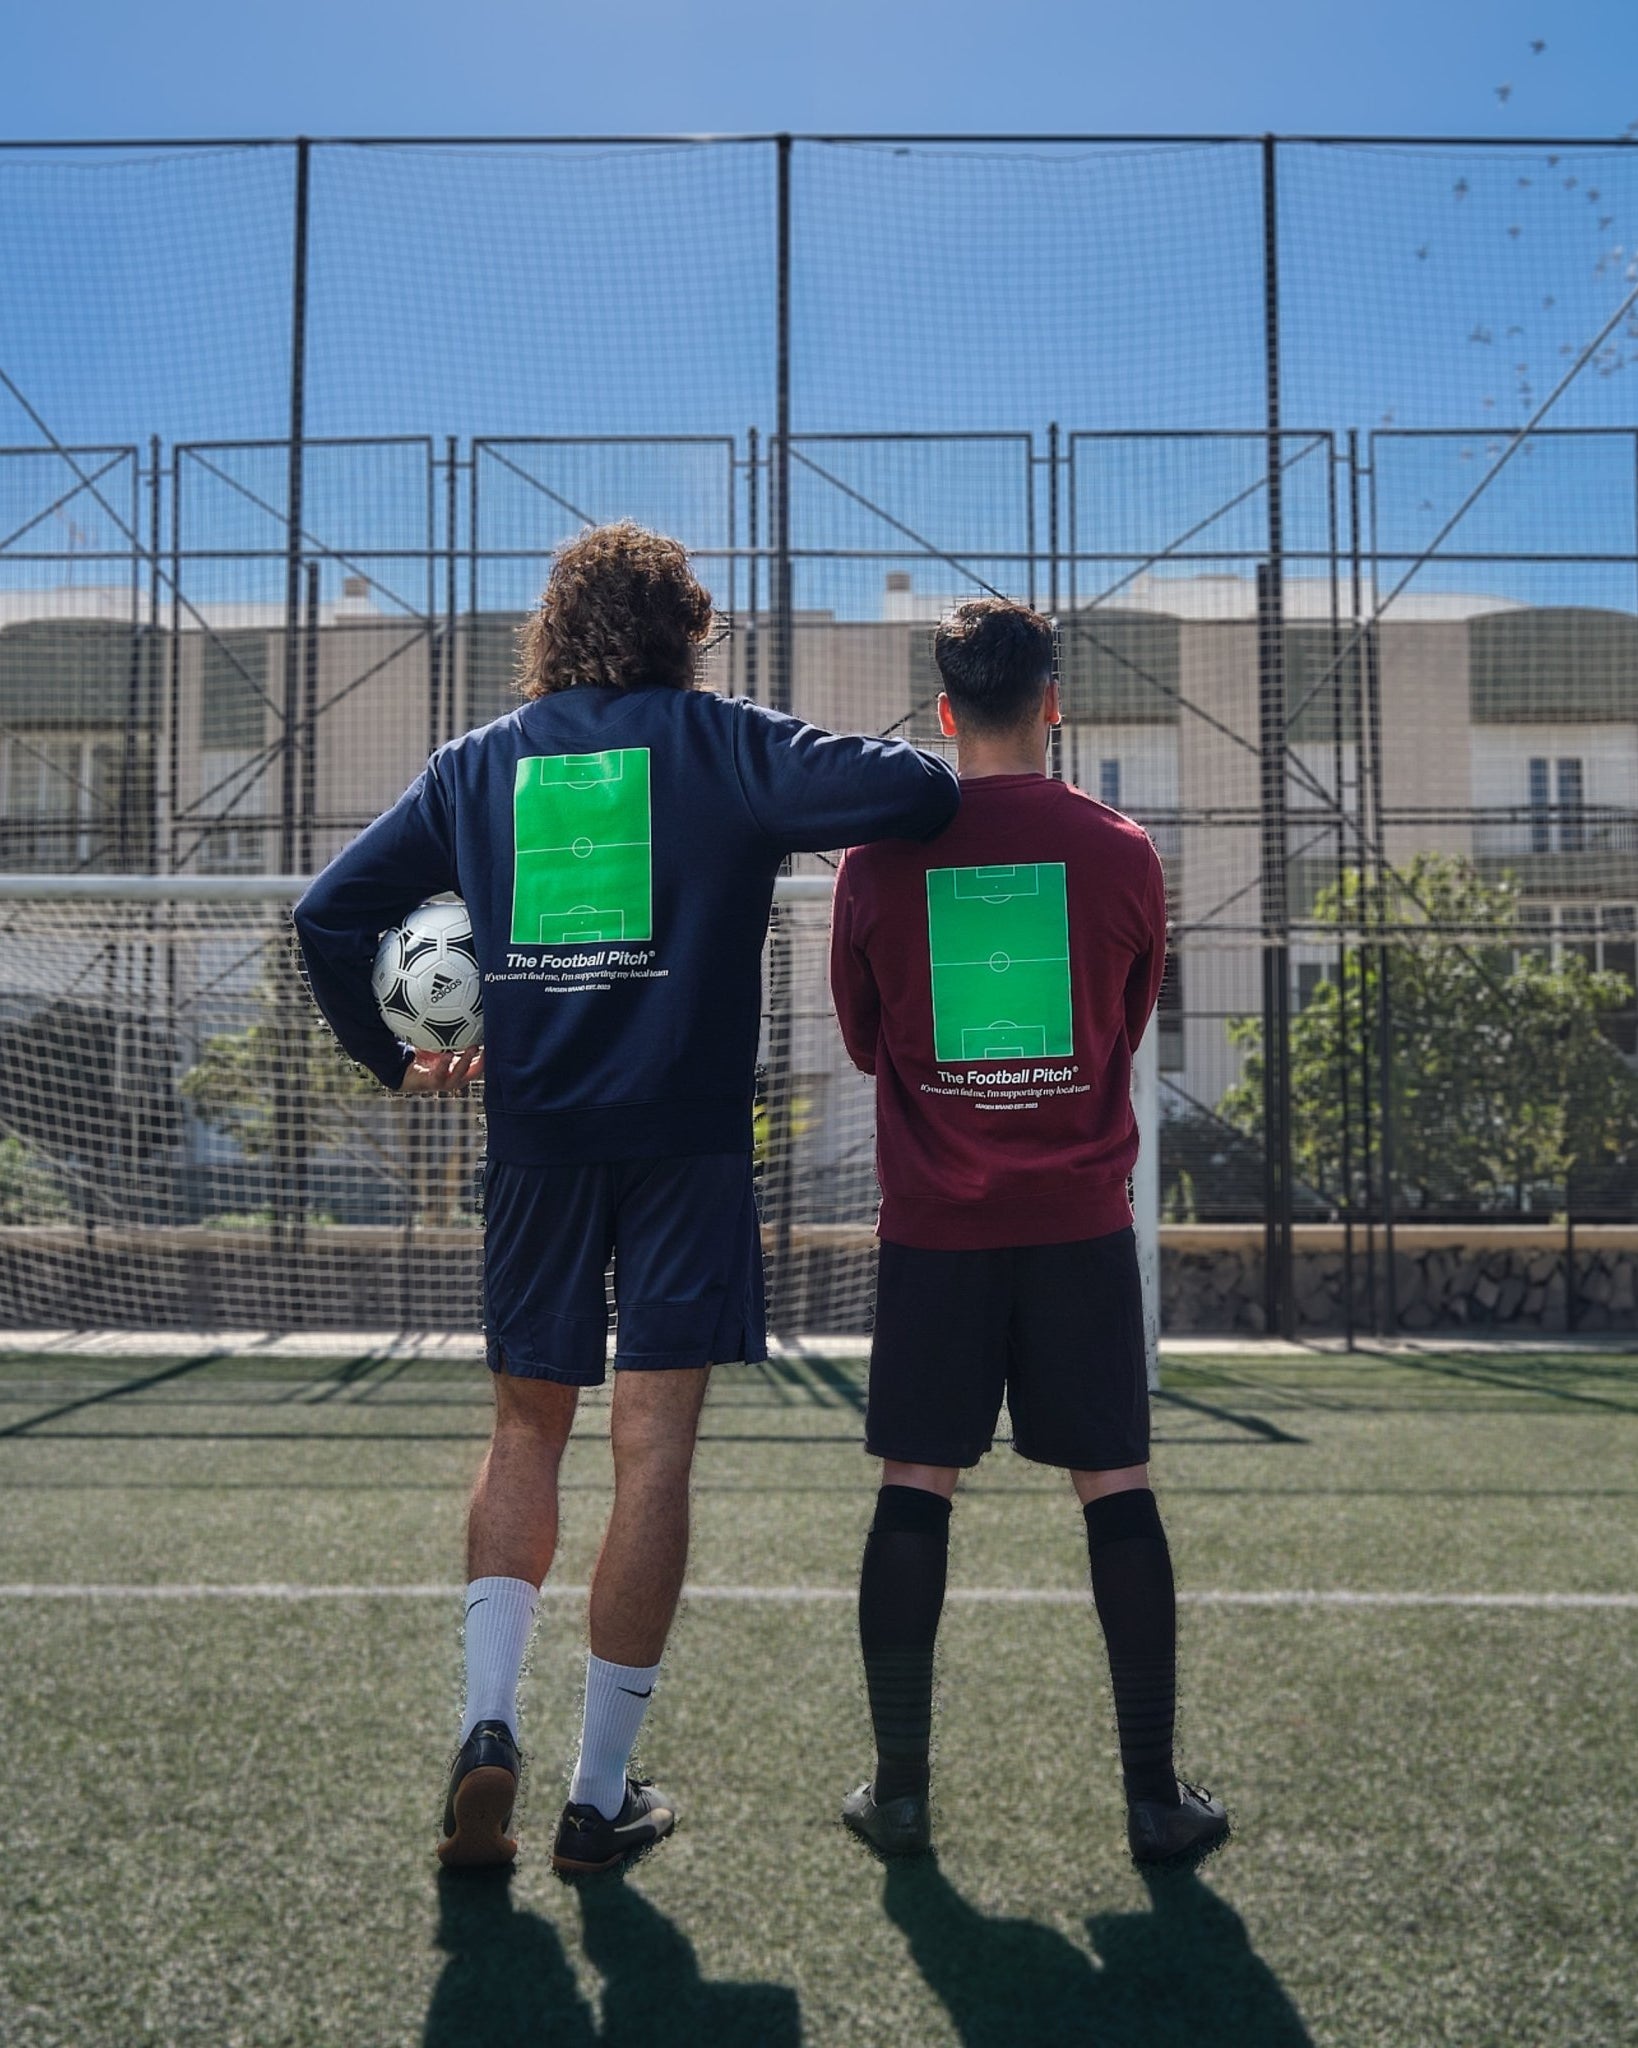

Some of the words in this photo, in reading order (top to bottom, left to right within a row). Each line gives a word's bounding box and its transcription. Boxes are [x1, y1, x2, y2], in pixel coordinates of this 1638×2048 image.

[506, 953, 538, 968] The
[540, 951, 605, 969] Football
[484, 972, 493, 982] If
[491, 973, 507, 983] you
[507, 971, 527, 981] can't
[528, 971, 545, 981] find
[545, 973, 560, 982] me,
[561, 972, 574, 981] I'm
[574, 969, 617, 982] supporting
[617, 971, 629, 980] my
[630, 968, 650, 979] local
[650, 969, 669, 978] team
[430, 978, 463, 1004] adidas
[937, 1070, 964, 1085] The
[967, 1068, 1030, 1086] Football
[920, 1083, 928, 1091] If
[926, 1085, 941, 1093] you
[960, 1087, 973, 1096] find
[973, 1090, 986, 1099] me,
[987, 1089, 999, 1098] I'm
[1000, 1087, 1043, 1100] supporting
[1043, 1087, 1055, 1097] my
[1056, 1084, 1074, 1095] local
[1075, 1084, 1091, 1093] team
